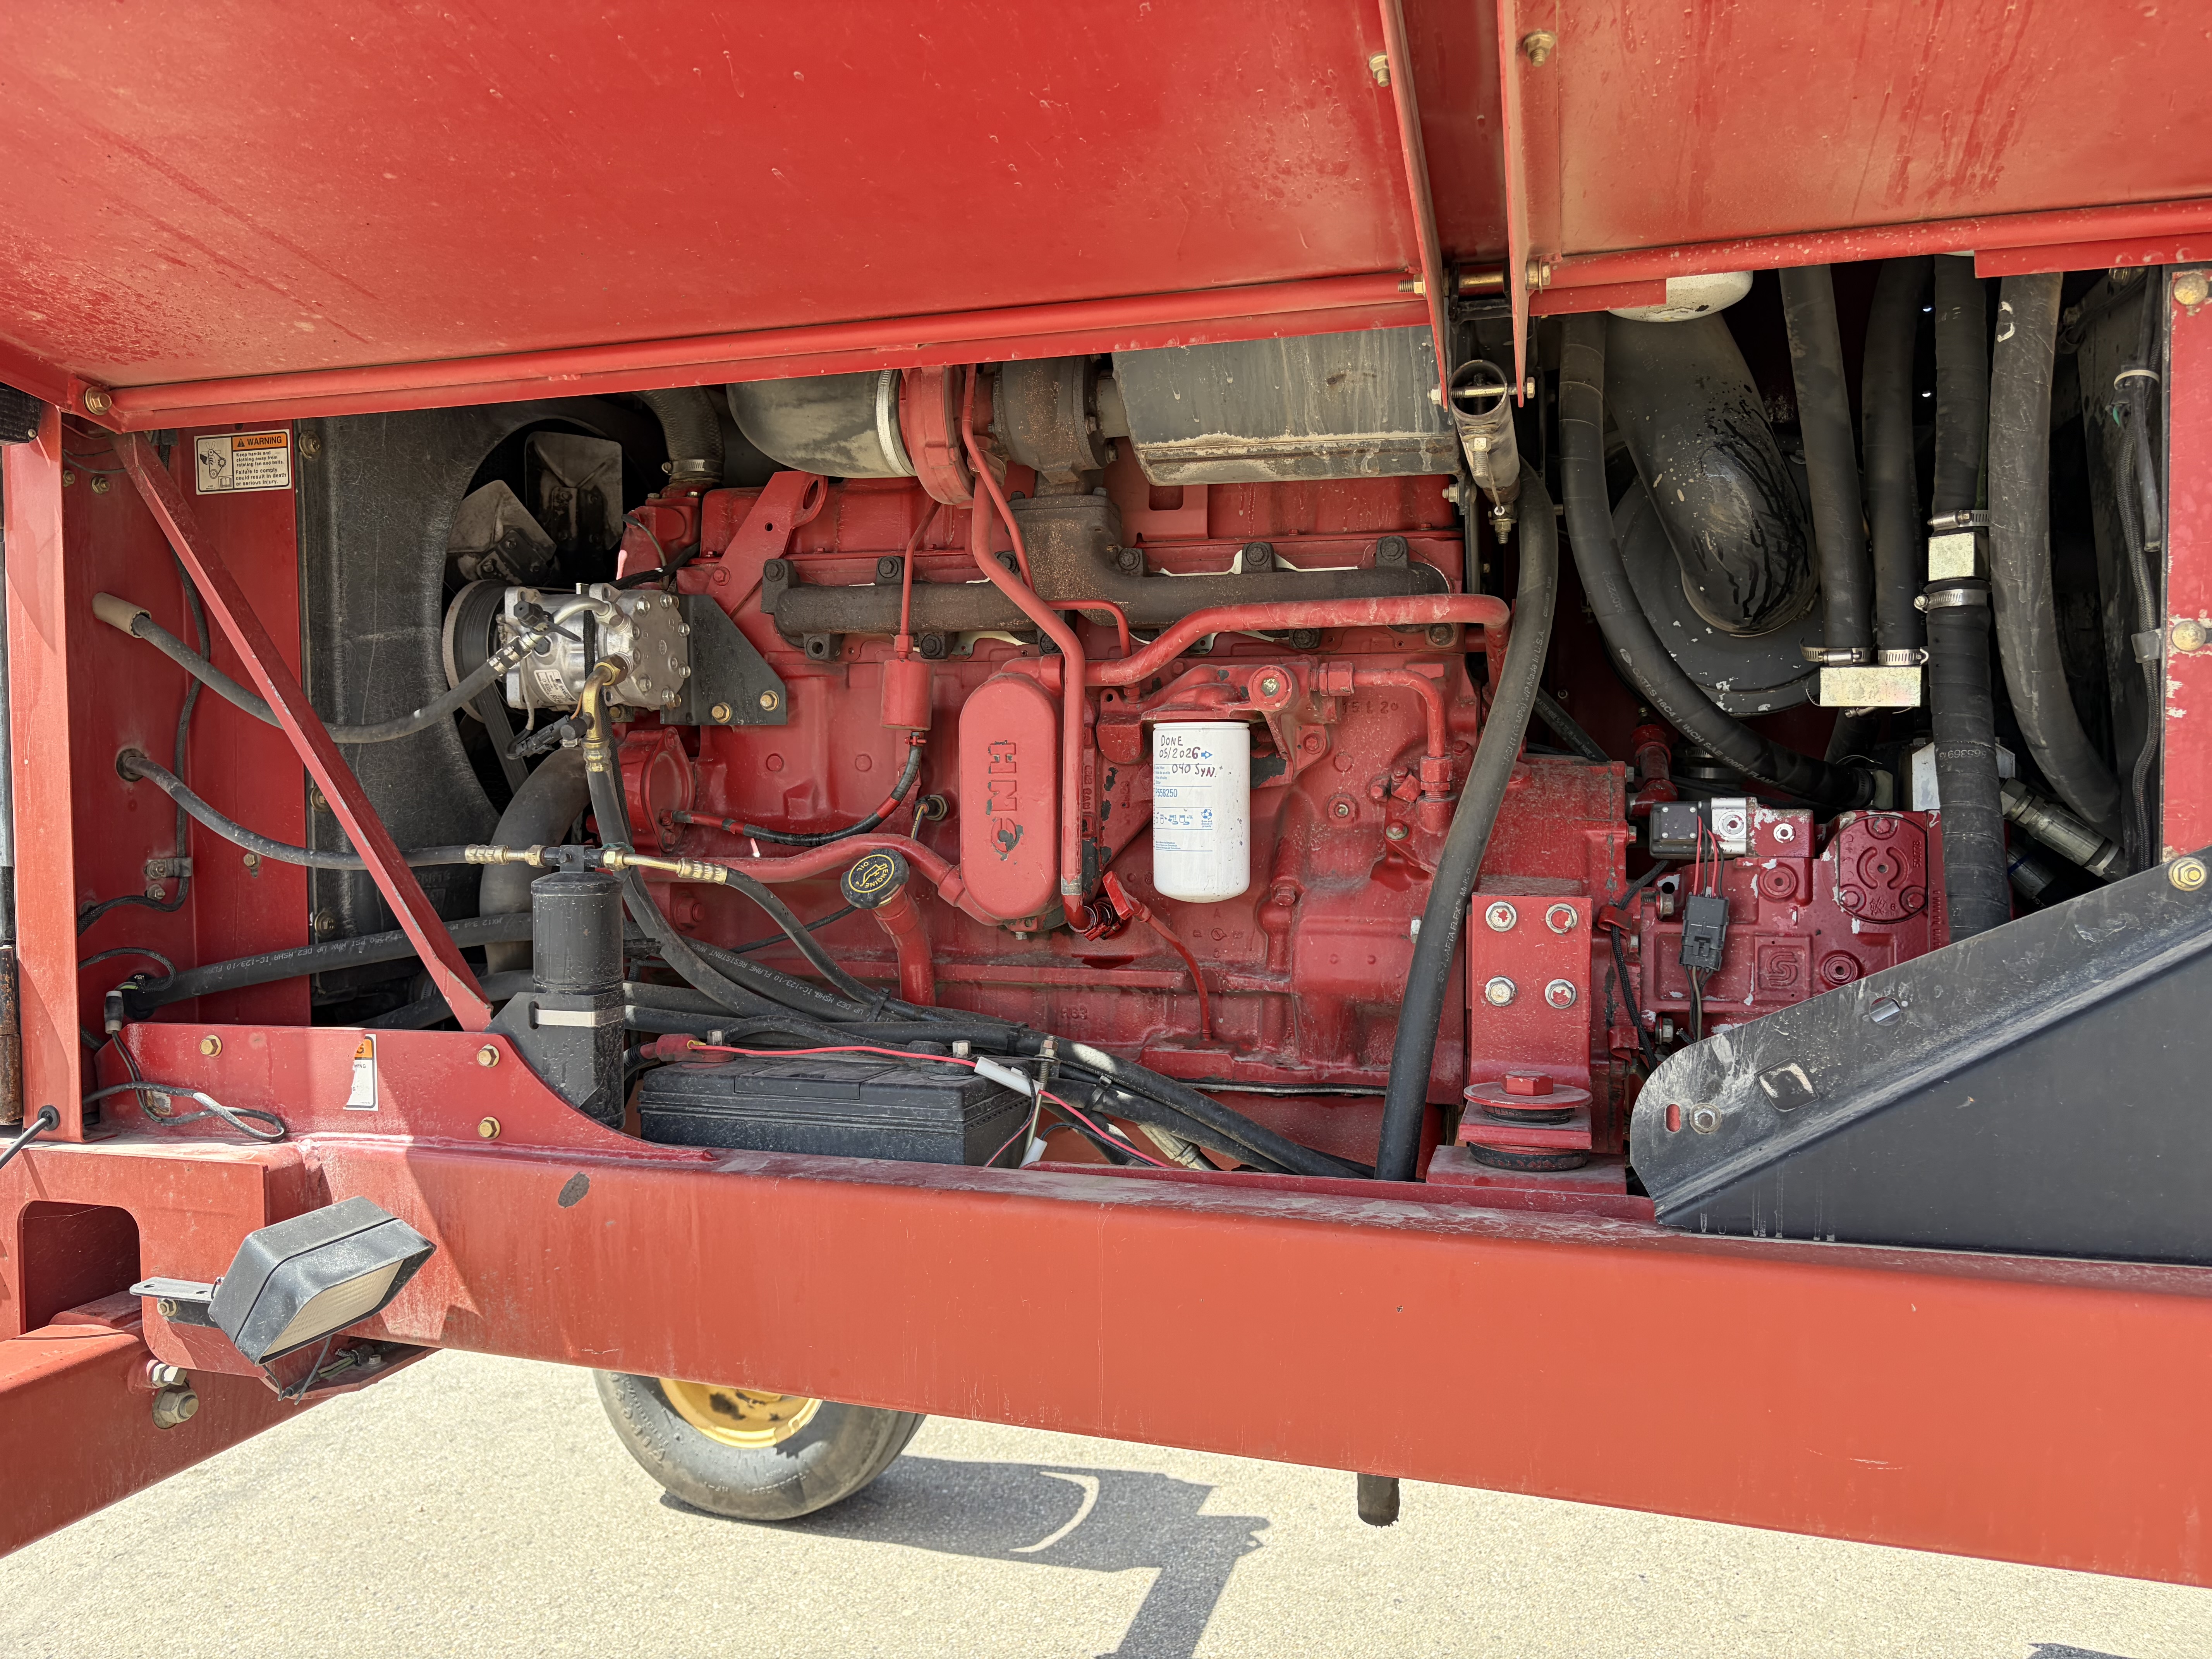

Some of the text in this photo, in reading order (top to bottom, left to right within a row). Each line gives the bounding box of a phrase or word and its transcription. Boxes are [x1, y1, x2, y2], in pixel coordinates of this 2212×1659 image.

[247, 436, 282, 445] WARNING
[1534, 630, 1545, 654] U.S.A.
[1532, 654, 1540, 663] In
[1527, 664, 1537, 687] Made
[1515, 702, 1528, 723] MPa)
[1632, 667, 1657, 697] GATES
[1683, 724, 1705, 743] INCH
[1704, 742, 1724, 757] SAE
[1161, 735, 1183, 746] DONE
[1159, 747, 1201, 759] 05/2026
[1172, 763, 1191, 774] 040
[1155, 788, 1178, 797] P558250
[857, 861, 869, 872] OIL
[864, 869, 889, 888] ENGINE
[297, 948, 313, 956] DE2
[317, 945, 327, 954] WP
[689, 943, 708, 953] MADE
[273, 951, 294, 961] MSHA
[708, 950, 749, 969] RESISTANT
[227, 955, 269, 970] IC-123/10
[749, 966, 773, 978] FLAME
[774, 975, 813, 995] IC-123/10
[836, 1000, 852, 1010] DE2
[854, 1007, 864, 1015] WP
